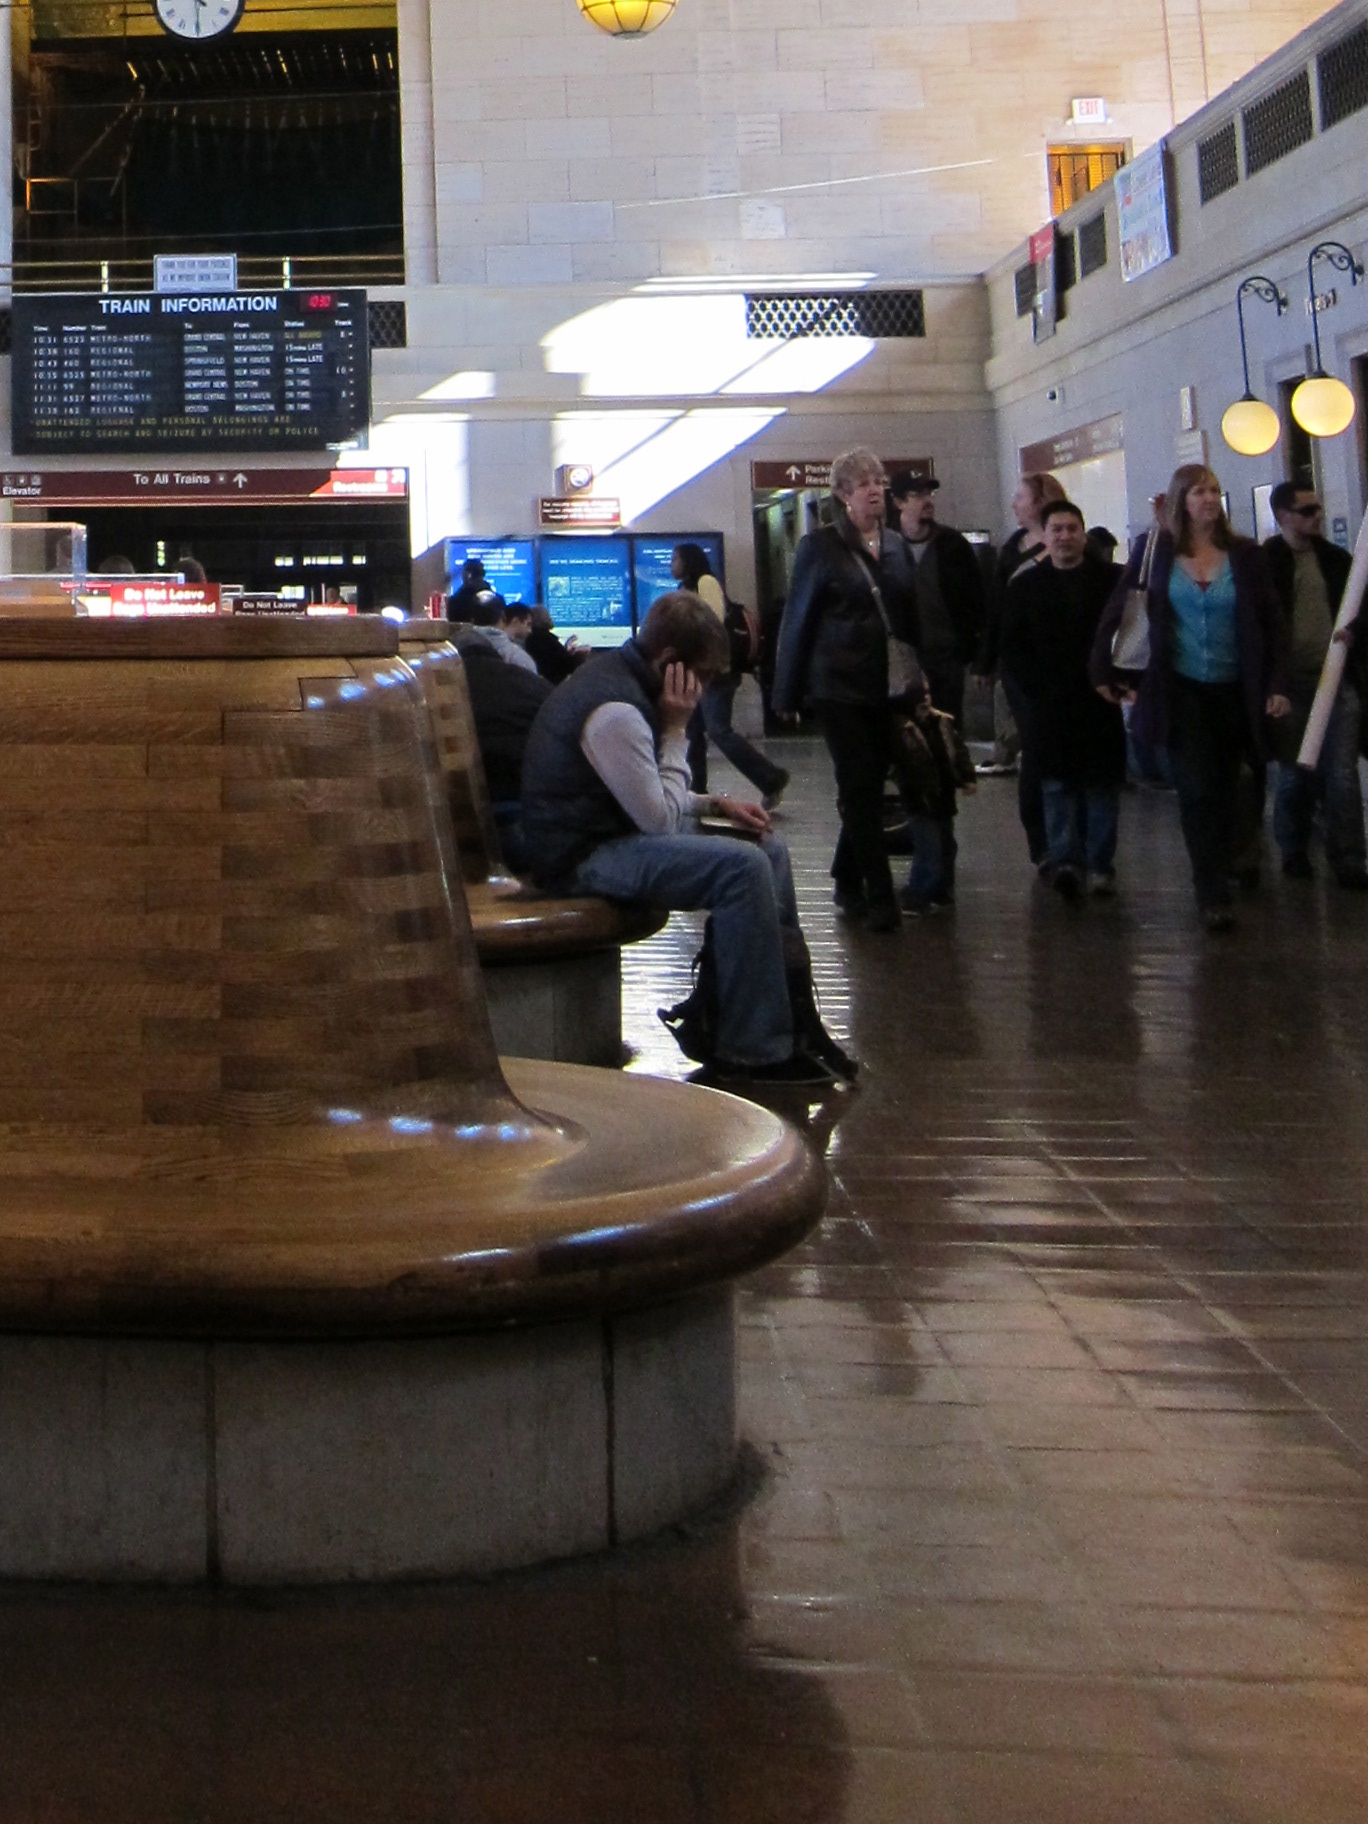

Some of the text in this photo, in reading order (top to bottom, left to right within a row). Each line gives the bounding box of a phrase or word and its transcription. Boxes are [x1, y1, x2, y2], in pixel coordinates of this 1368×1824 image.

[1079, 100, 1098, 116] EXIT
[99, 296, 277, 314] TRAIN INFORMATION
[308, 343, 323, 351] LATE
[141, 417, 156, 425] AND
[162, 417, 206, 425] PERSONAL
[213, 416, 268, 424] BELONGINGS
[96, 429, 130, 438] SEARCH
[285, 427, 319, 435] POLICE
[805, 464, 832, 475] Parki
[134, 473, 211, 485] To All Trains
[2, 487, 42, 496] Elevator
[124, 588, 205, 601] Do Not Leave
[112, 601, 216, 615] Bags Unattended
[242, 601, 254, 609] Do
